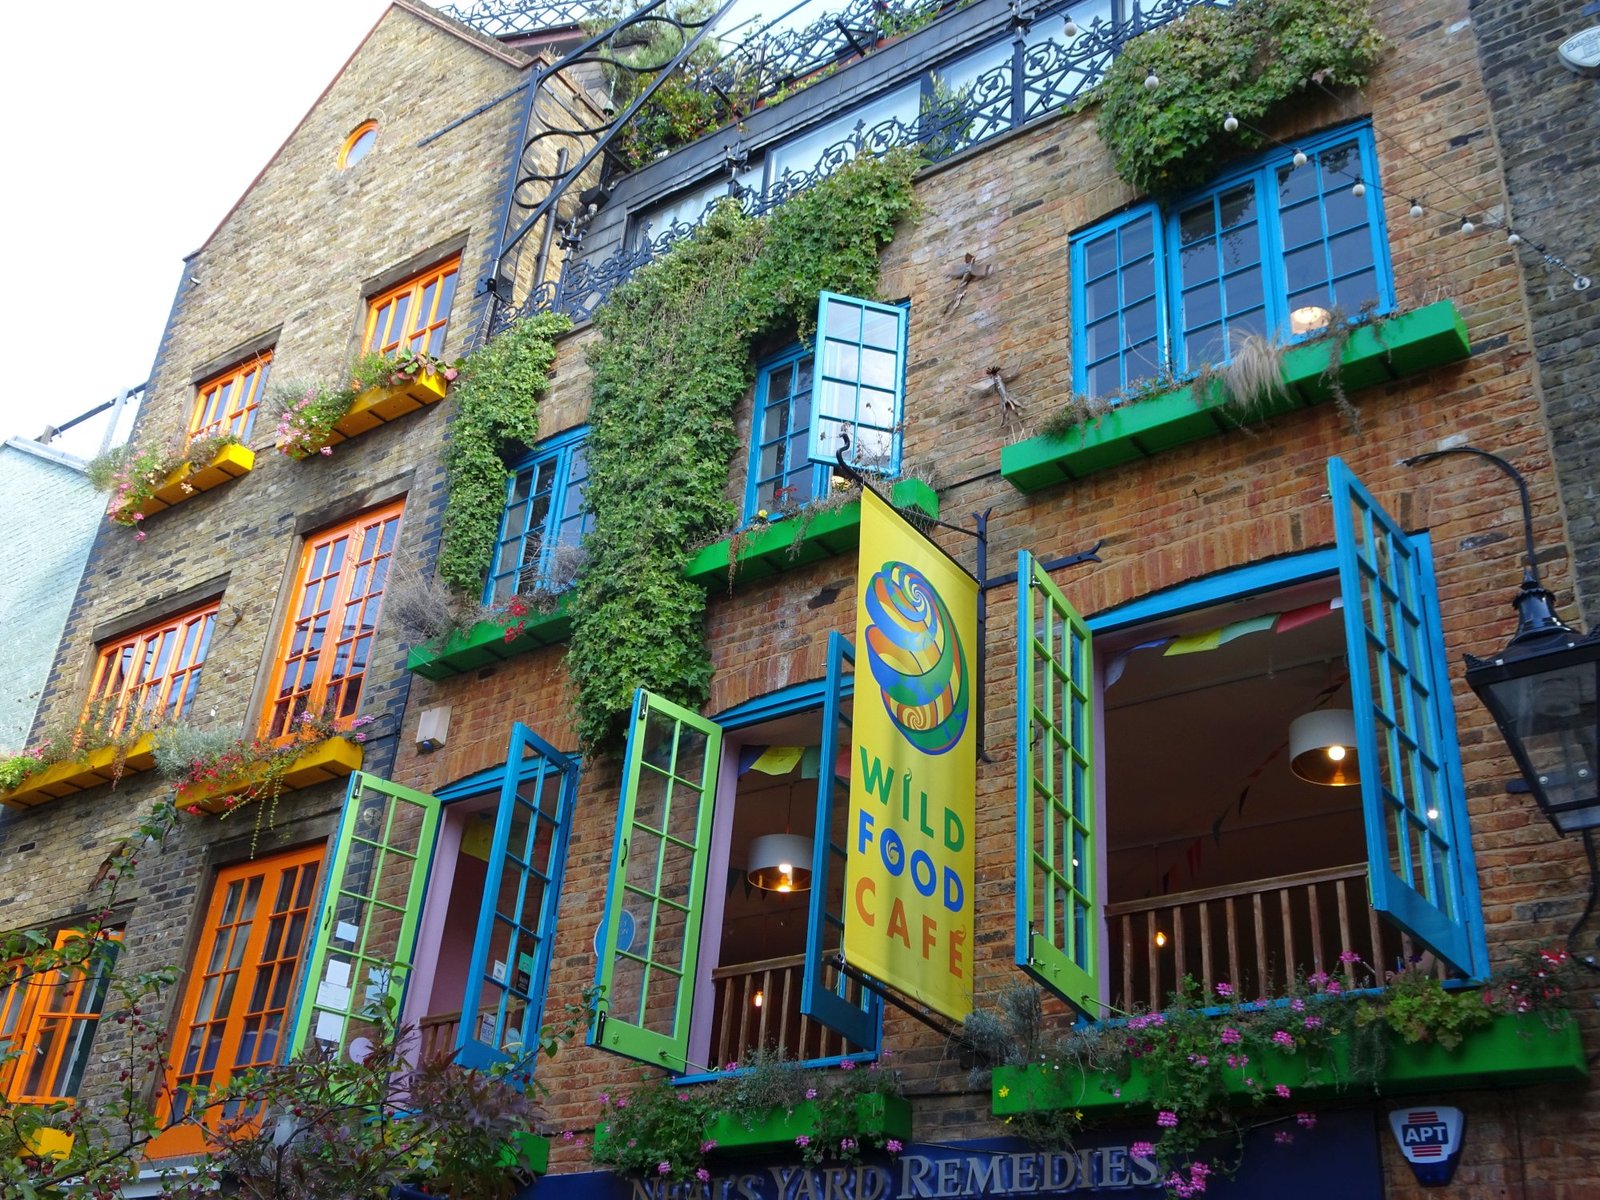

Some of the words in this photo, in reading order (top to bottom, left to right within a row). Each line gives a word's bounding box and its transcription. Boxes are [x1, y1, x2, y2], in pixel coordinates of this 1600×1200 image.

[860, 745, 964, 852] WILD
[858, 808, 964, 912] FOOD
[767, 1164, 884, 1200] YARD
[897, 1146, 1158, 1199] REMEDIES
[1405, 1126, 1446, 1143] APT
